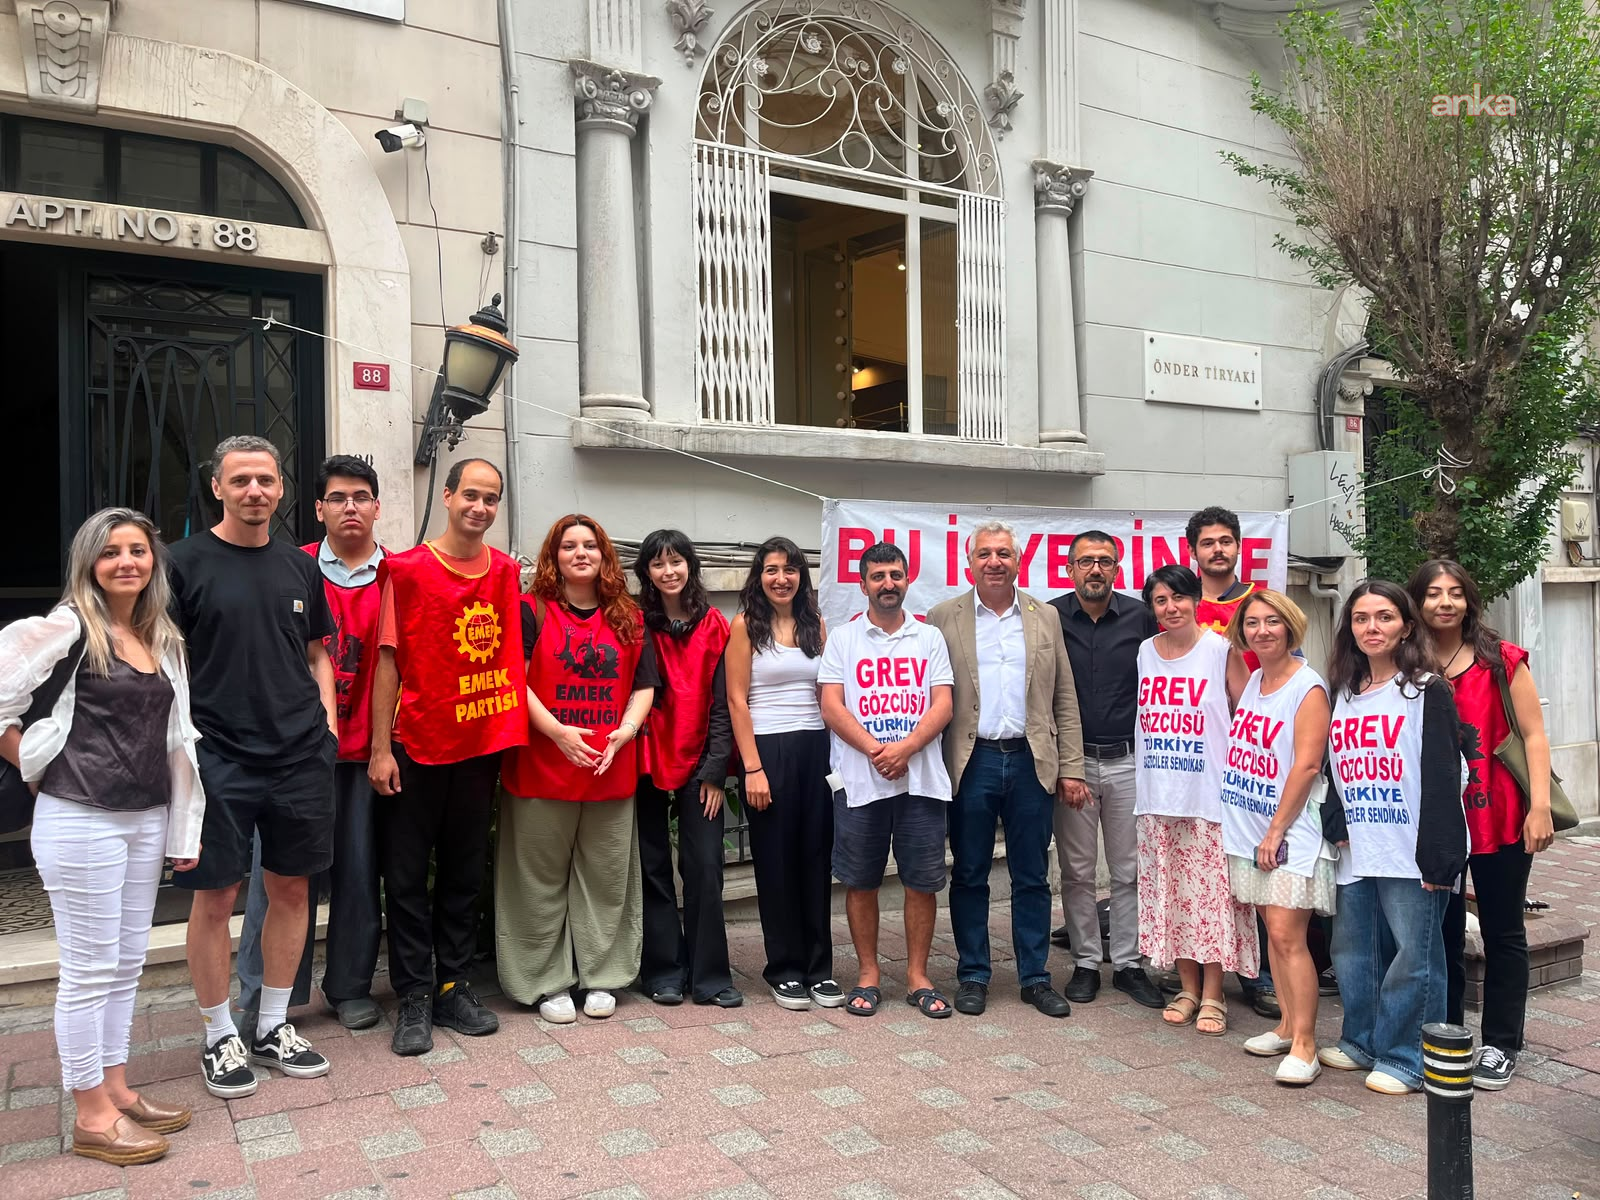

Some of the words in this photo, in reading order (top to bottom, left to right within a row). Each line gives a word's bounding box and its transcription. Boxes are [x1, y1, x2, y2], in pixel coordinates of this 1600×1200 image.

[6, 197, 102, 236] APT.
[213, 220, 258, 251] 88
[362, 368, 382, 383] 88
[1153, 358, 1199, 378] ÖNDER
[1205, 366, 1256, 384] TİRYAKİ
[459, 668, 512, 695] EMEK
[856, 657, 928, 688] GREV
[456, 686, 518, 723] PARTİSİ
[556, 685, 614, 701] EMEK
[859, 689, 926, 717] GÖZCÜSÜ
[1139, 676, 1208, 707] GREV
[863, 716, 919, 733] TÜRKİY
[1229, 708, 1285, 750] GREV
[1330, 715, 1406, 753] GREV
[1170, 754, 1205, 773] SENDİKASI
[1226, 741, 1278, 780] ÖZCÜSÜ
[1336, 751, 1403, 784] ÖZCÜSÜ
[1247, 797, 1279, 817] SENDİKAS
[1344, 784, 1403, 803] ÜRKİYE
[1368, 804, 1411, 825] SENDİKASI
